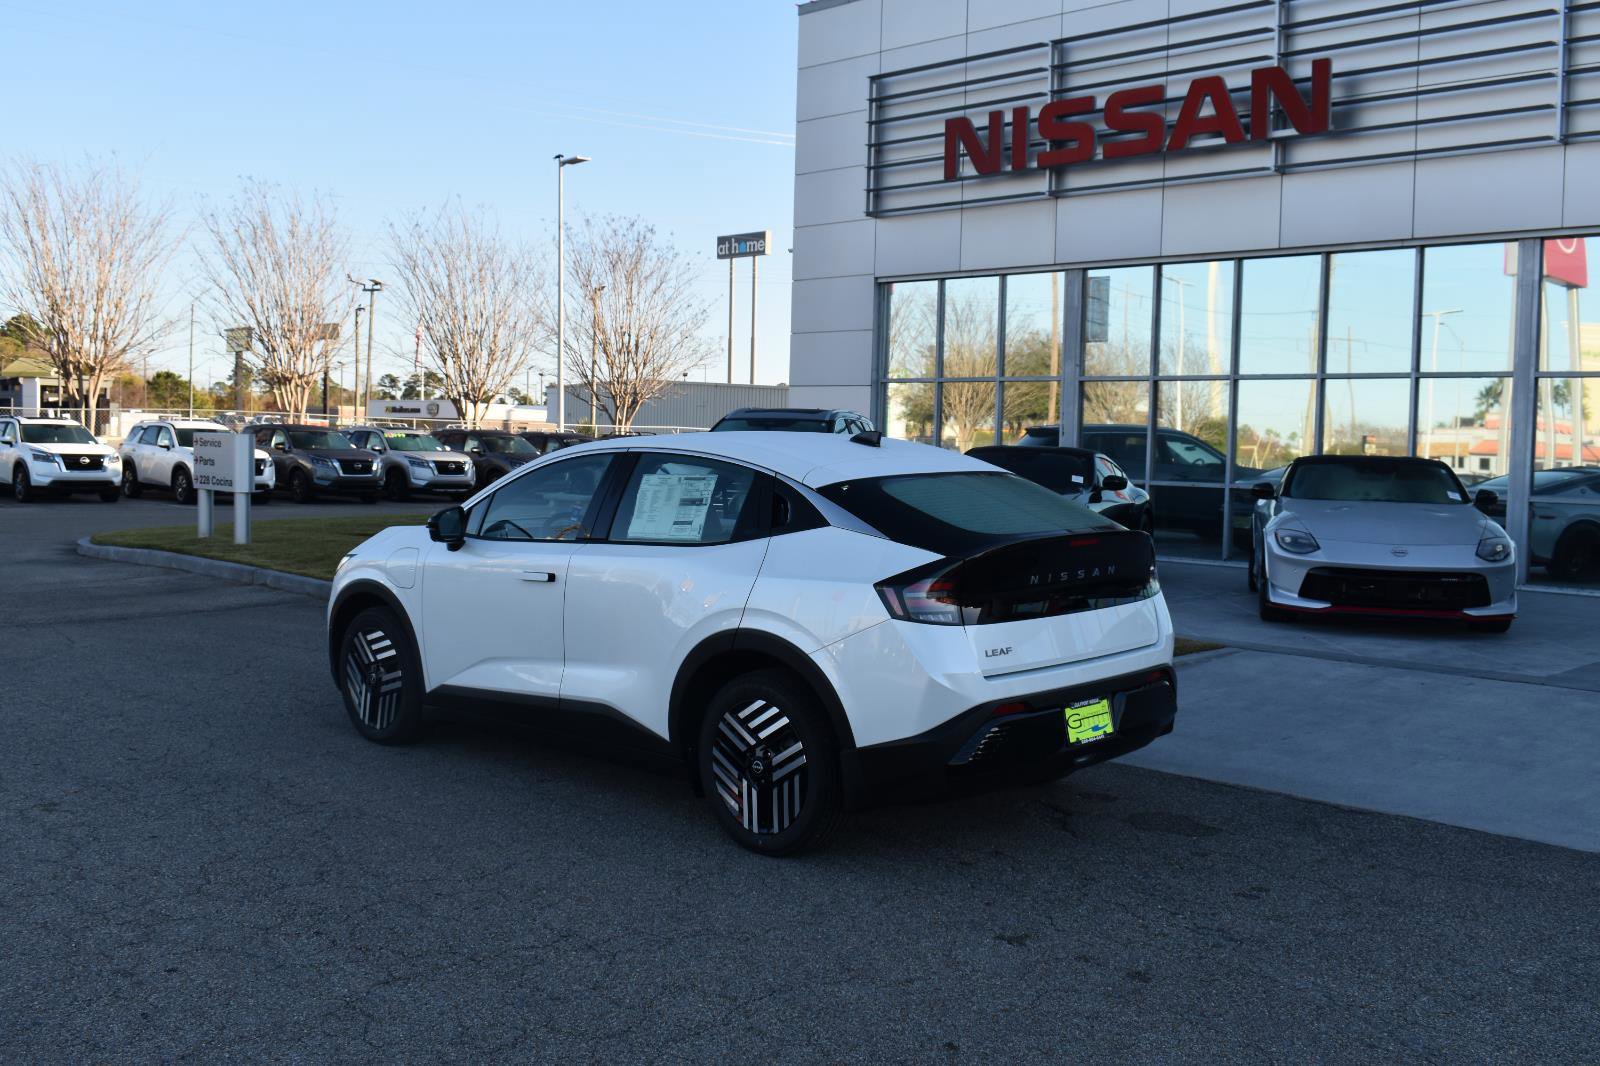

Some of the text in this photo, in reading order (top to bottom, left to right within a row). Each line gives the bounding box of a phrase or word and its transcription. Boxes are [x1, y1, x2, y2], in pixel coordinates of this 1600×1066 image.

[944, 58, 1332, 181] NISSAN
[718, 240, 730, 255] at
[199, 437, 222, 448] Service
[199, 455, 216, 466] Parts
[199, 475, 233, 487] 228 Cocina
[1030, 564, 1116, 585] NISSAN
[985, 646, 1013, 658] LEAF
